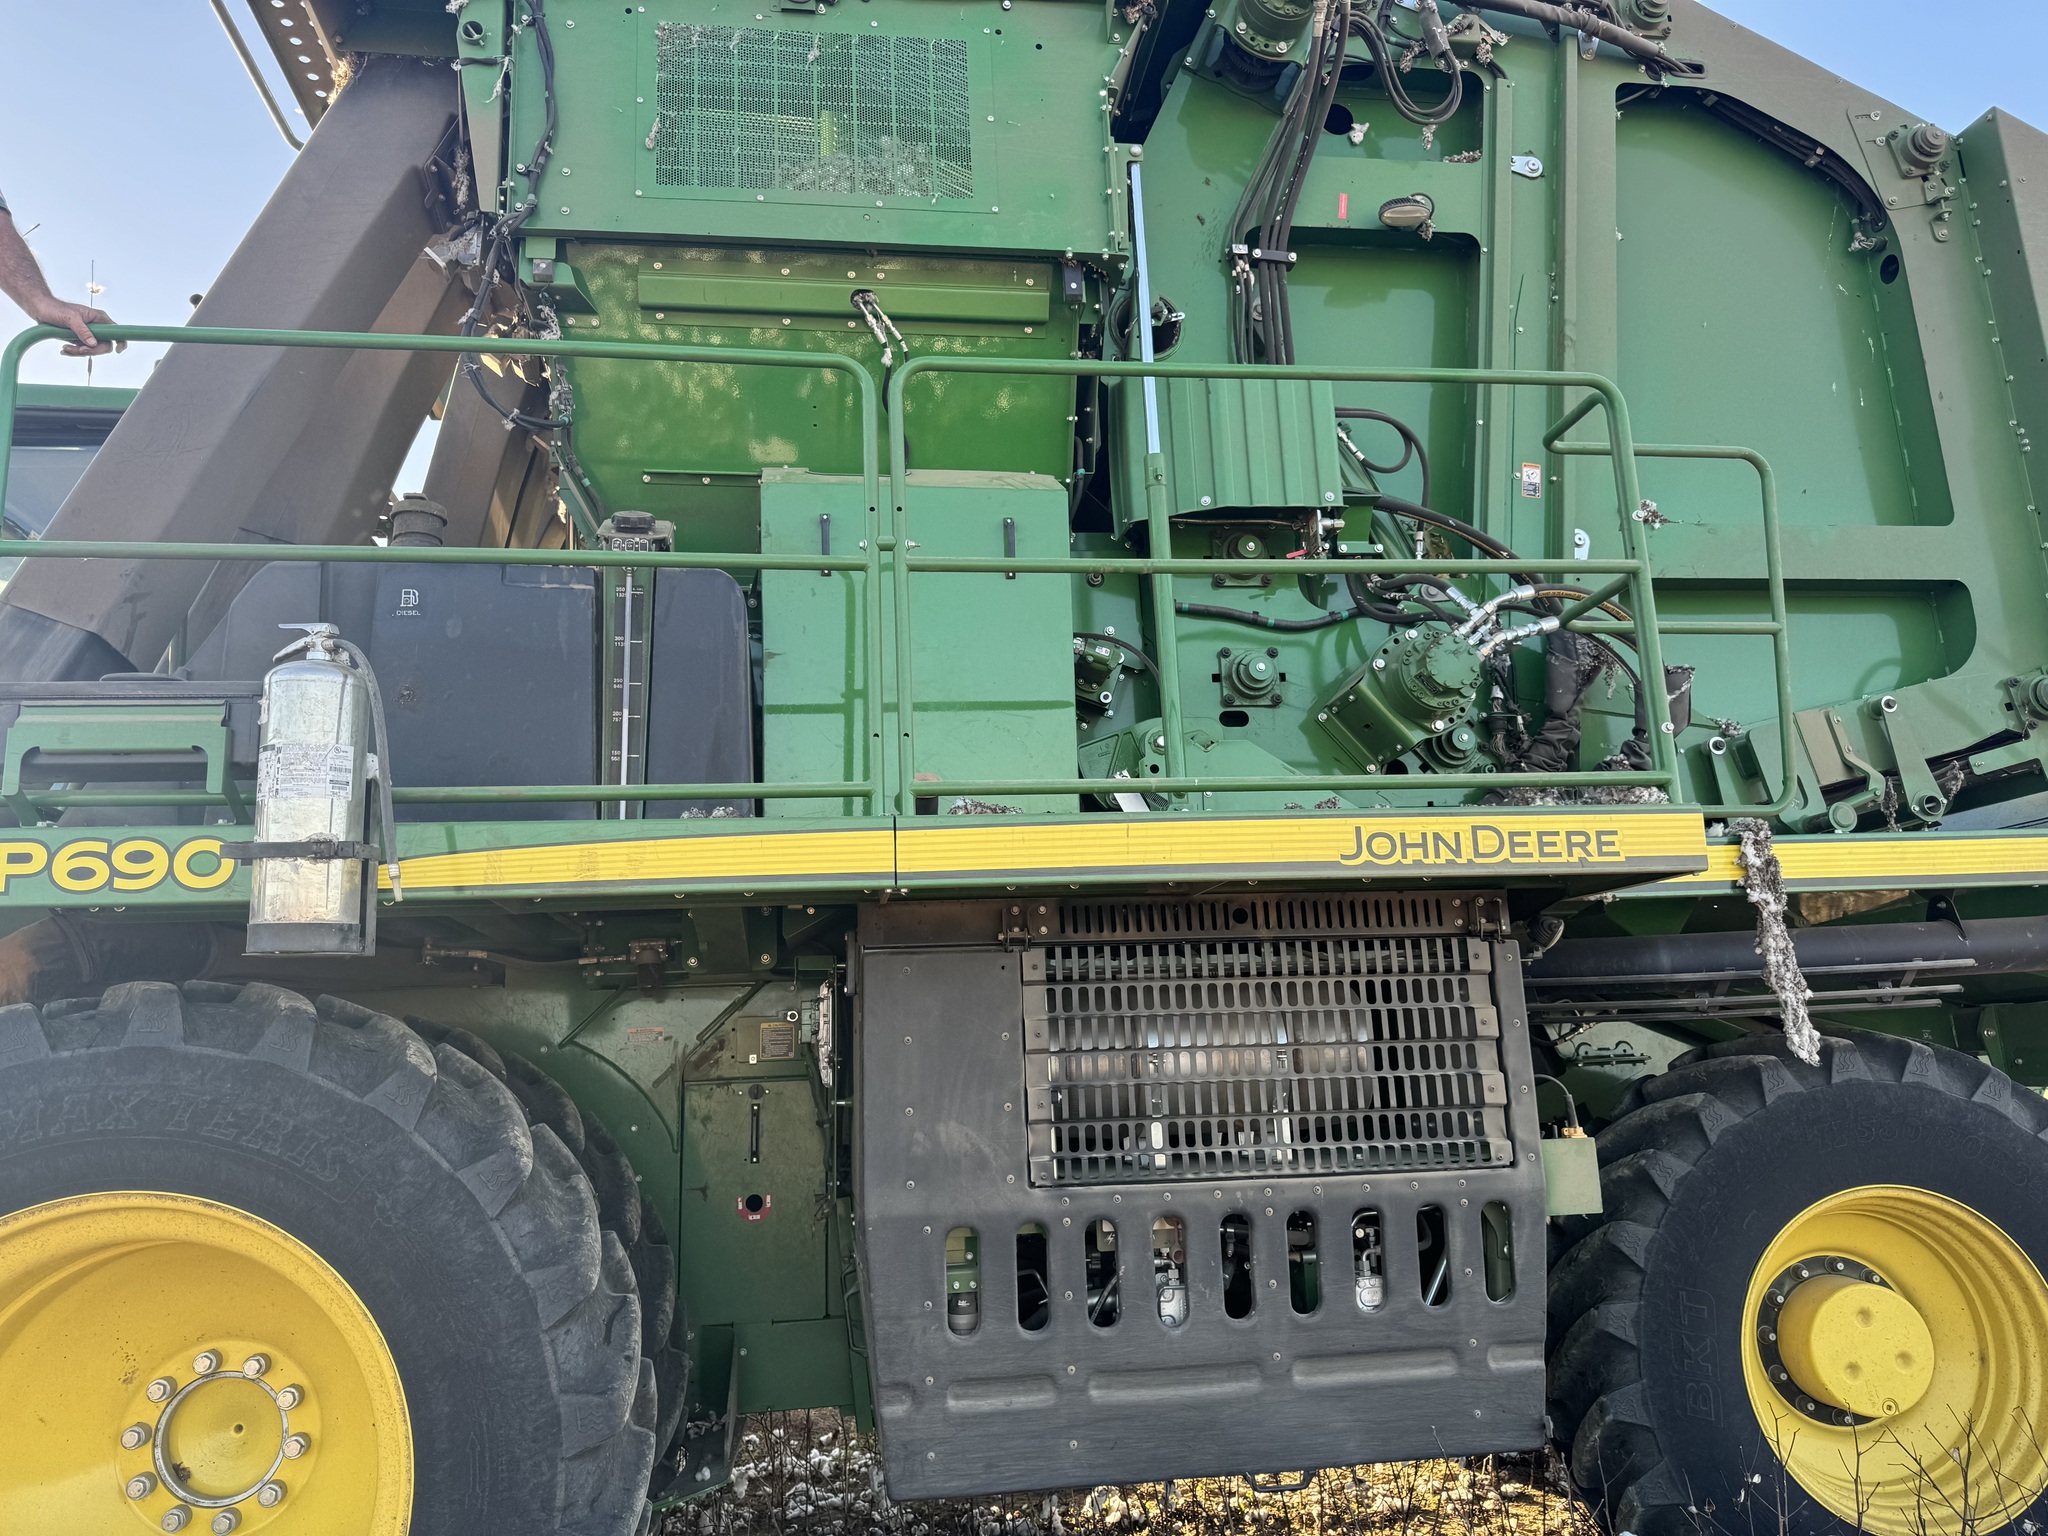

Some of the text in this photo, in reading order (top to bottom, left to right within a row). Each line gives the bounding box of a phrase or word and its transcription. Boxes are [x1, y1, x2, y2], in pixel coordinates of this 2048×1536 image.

[1340, 825, 1621, 861] JOHN DEERE
[1679, 1290, 1715, 1421] BKT
